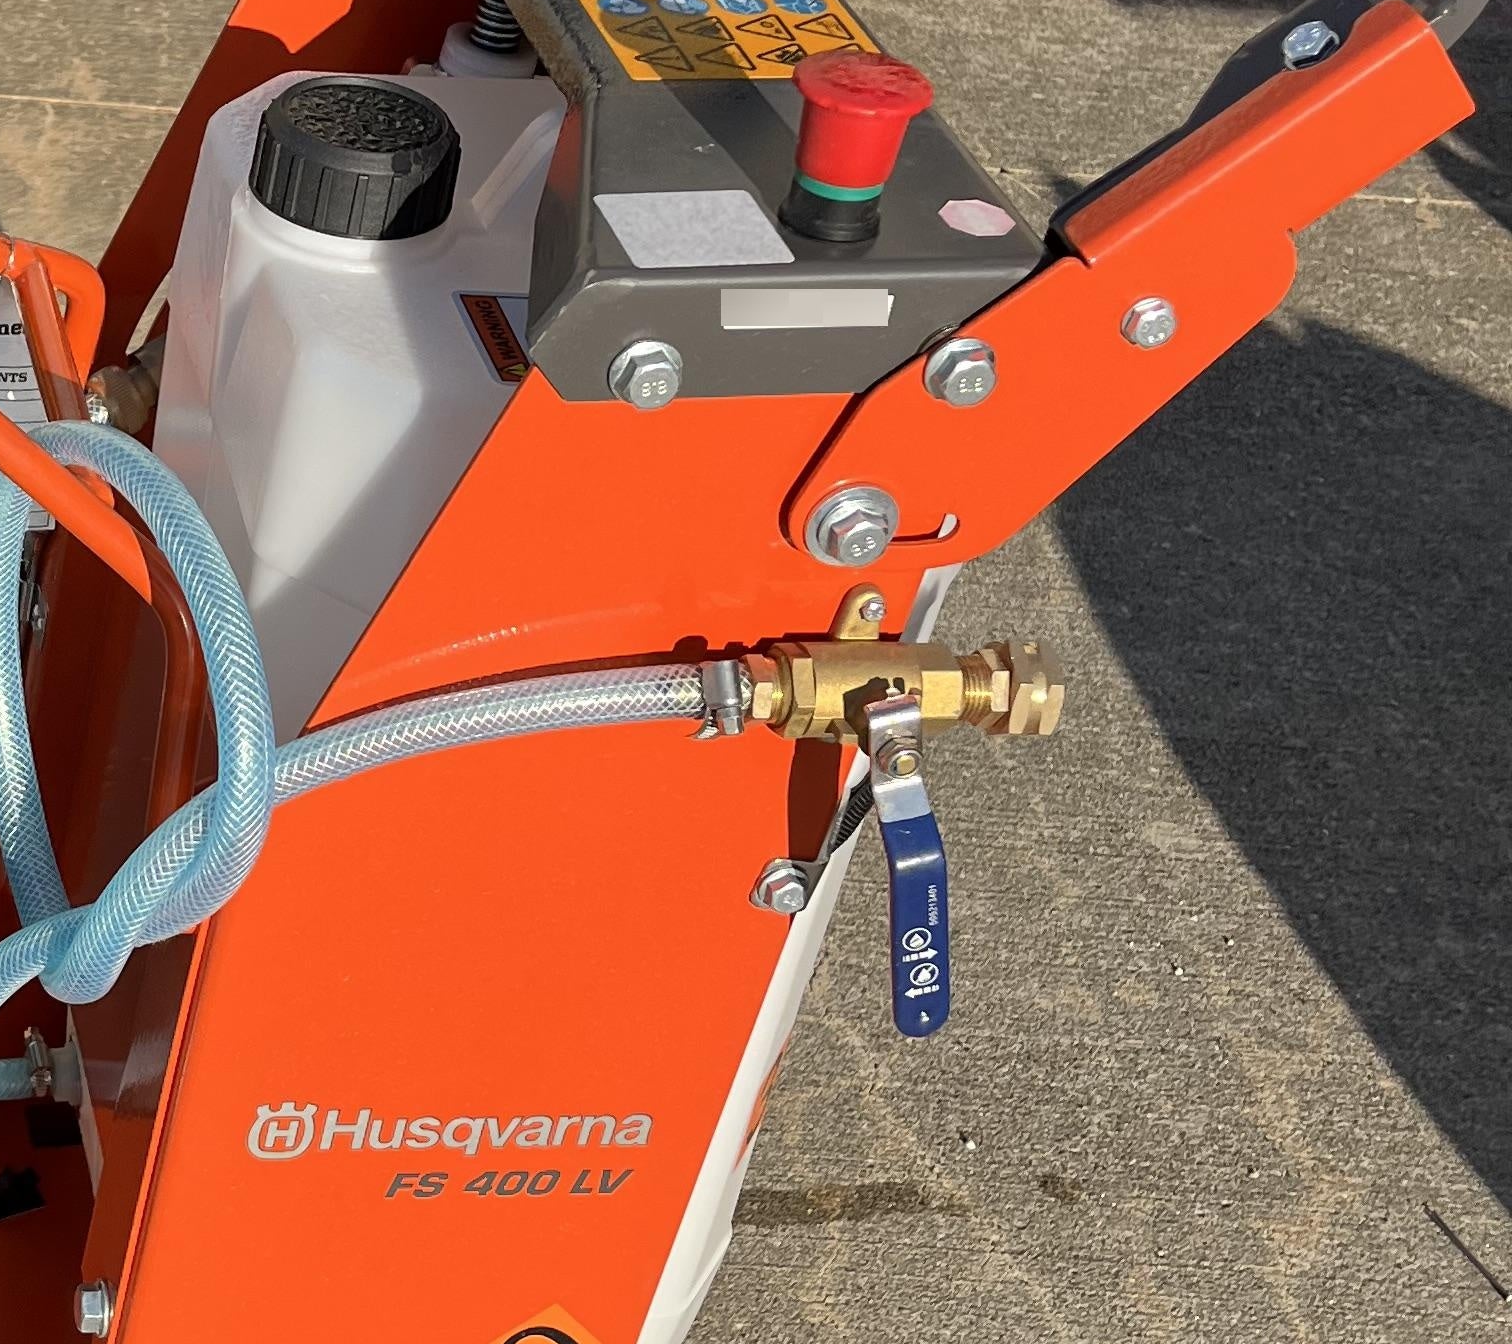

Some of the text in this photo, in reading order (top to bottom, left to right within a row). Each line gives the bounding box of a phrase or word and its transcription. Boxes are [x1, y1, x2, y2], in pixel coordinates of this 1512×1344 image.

[474, 299, 519, 362] WARNING
[319, 1108, 655, 1157] Husqvarna
[384, 1167, 635, 1199] FS 400 LV
